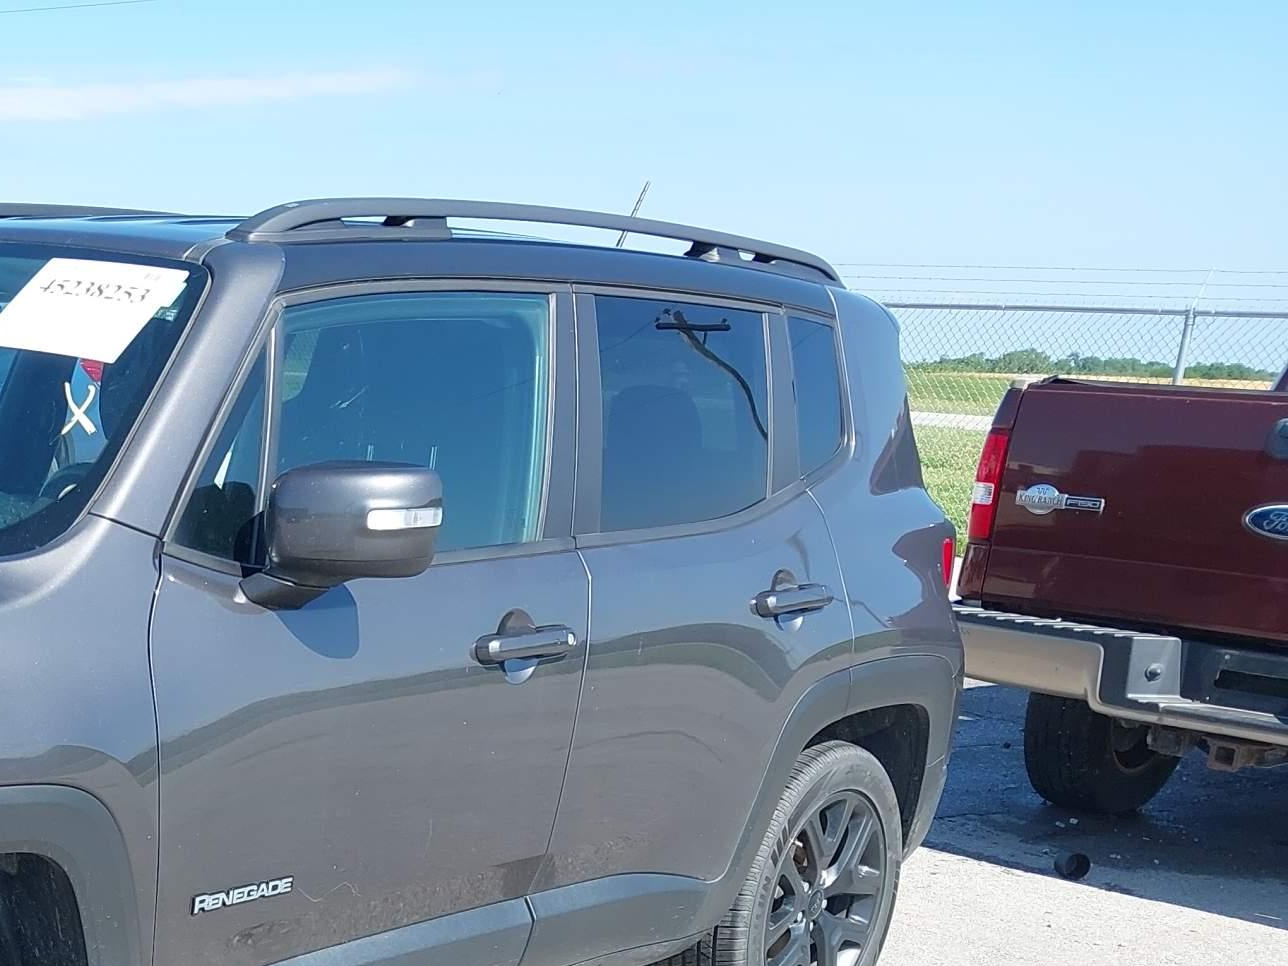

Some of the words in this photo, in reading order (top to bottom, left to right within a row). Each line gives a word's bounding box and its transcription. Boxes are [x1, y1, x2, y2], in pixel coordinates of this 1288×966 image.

[40, 279, 151, 303] 45238253
[1019, 492, 1037, 504] KING
[1037, 494, 1064, 507] RANCH
[1263, 511, 1288, 532] Fo
[192, 876, 295, 915] RENEGADE
